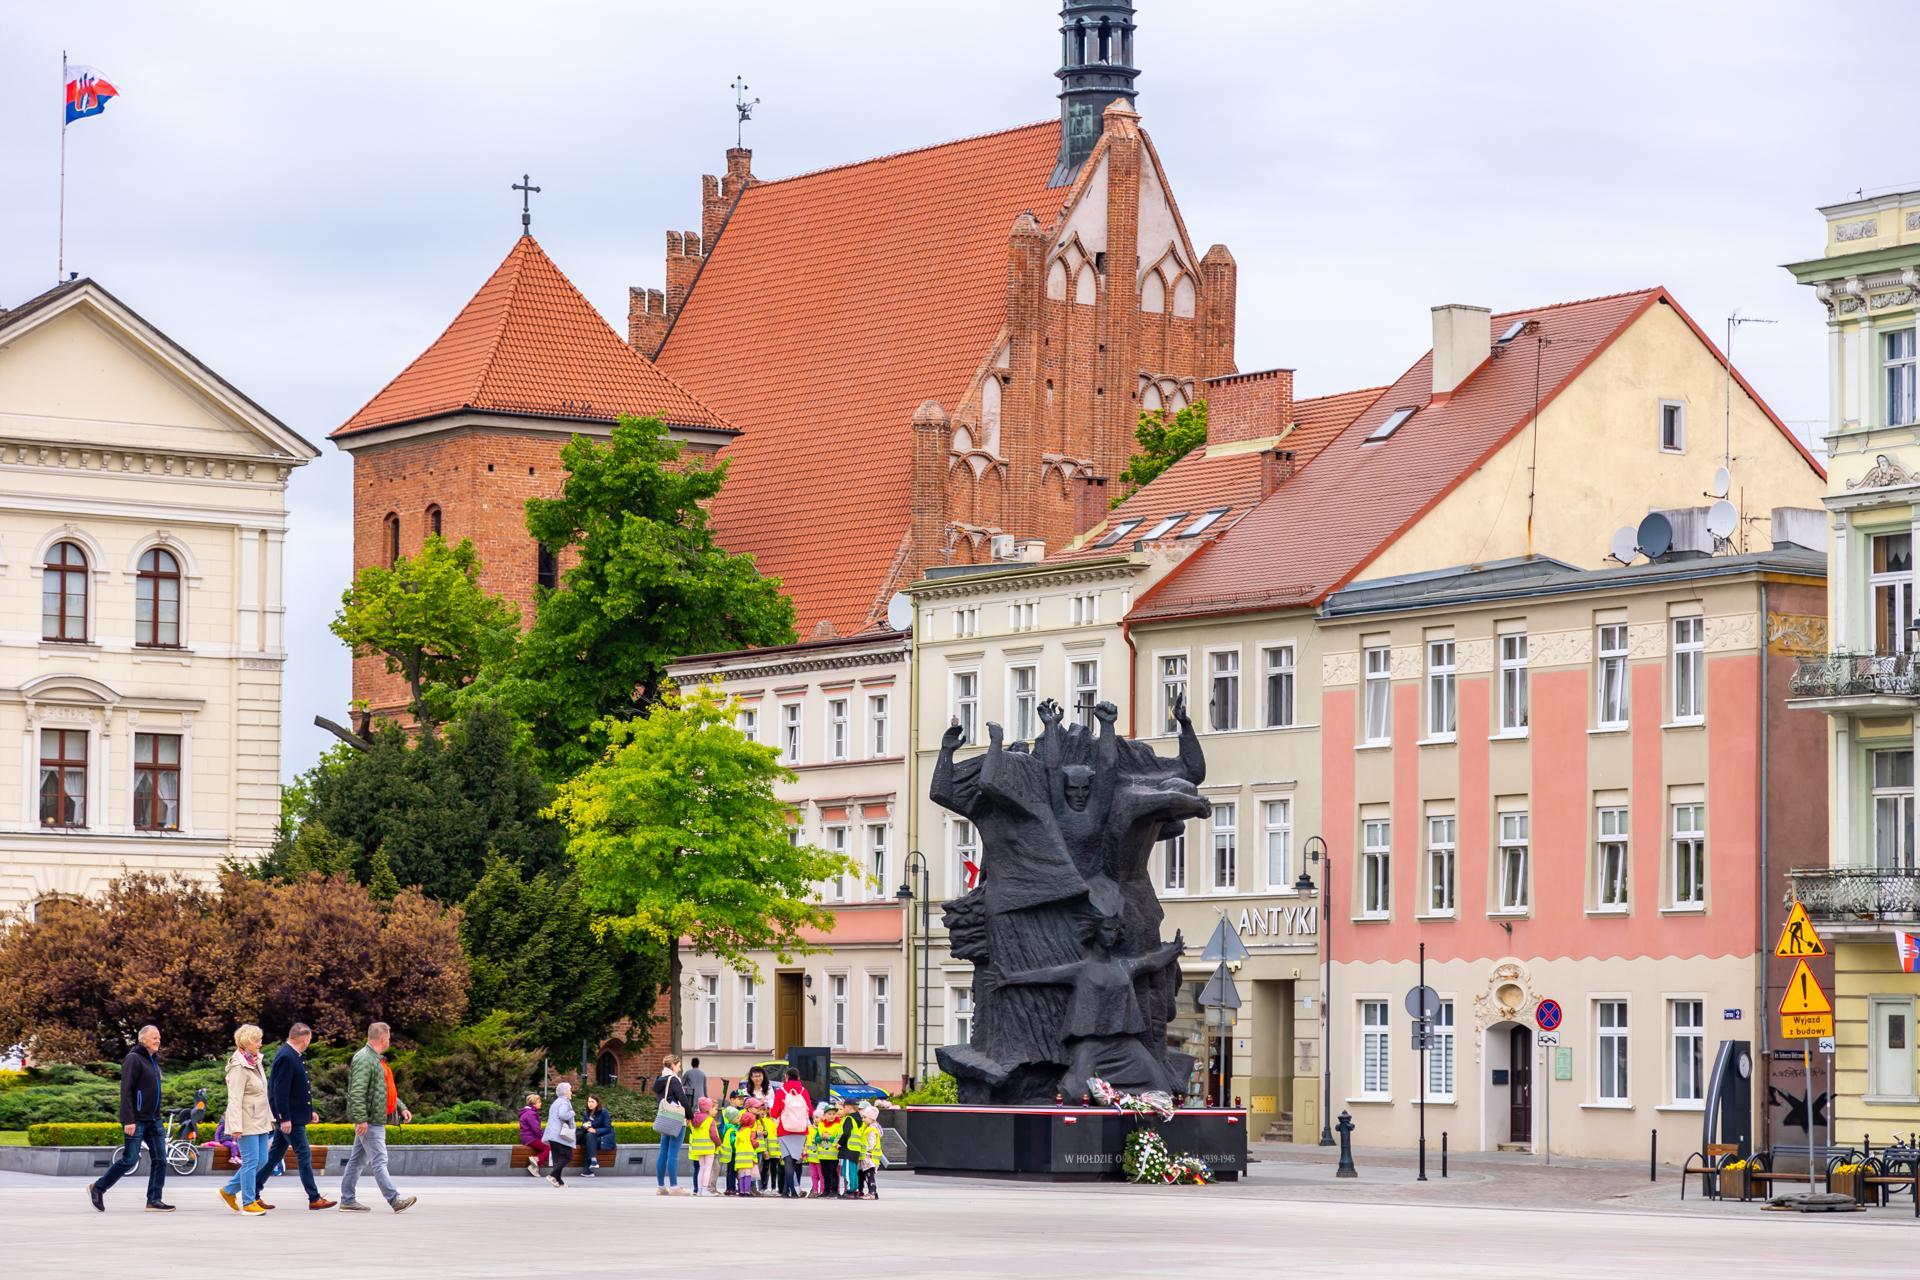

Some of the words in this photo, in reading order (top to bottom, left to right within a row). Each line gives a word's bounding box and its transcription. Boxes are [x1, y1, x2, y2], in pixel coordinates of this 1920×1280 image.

[1238, 907, 1317, 935] ANTYKI
[1735, 1010, 1740, 1019] 2
[1793, 1016, 1820, 1025] Wyjazd
[1796, 1027, 1826, 1036] budowy
[1064, 1154, 1074, 1164] W
[1076, 1154, 1113, 1164] HOŁDZIE
[1202, 1154, 1236, 1164] 1939-1945
